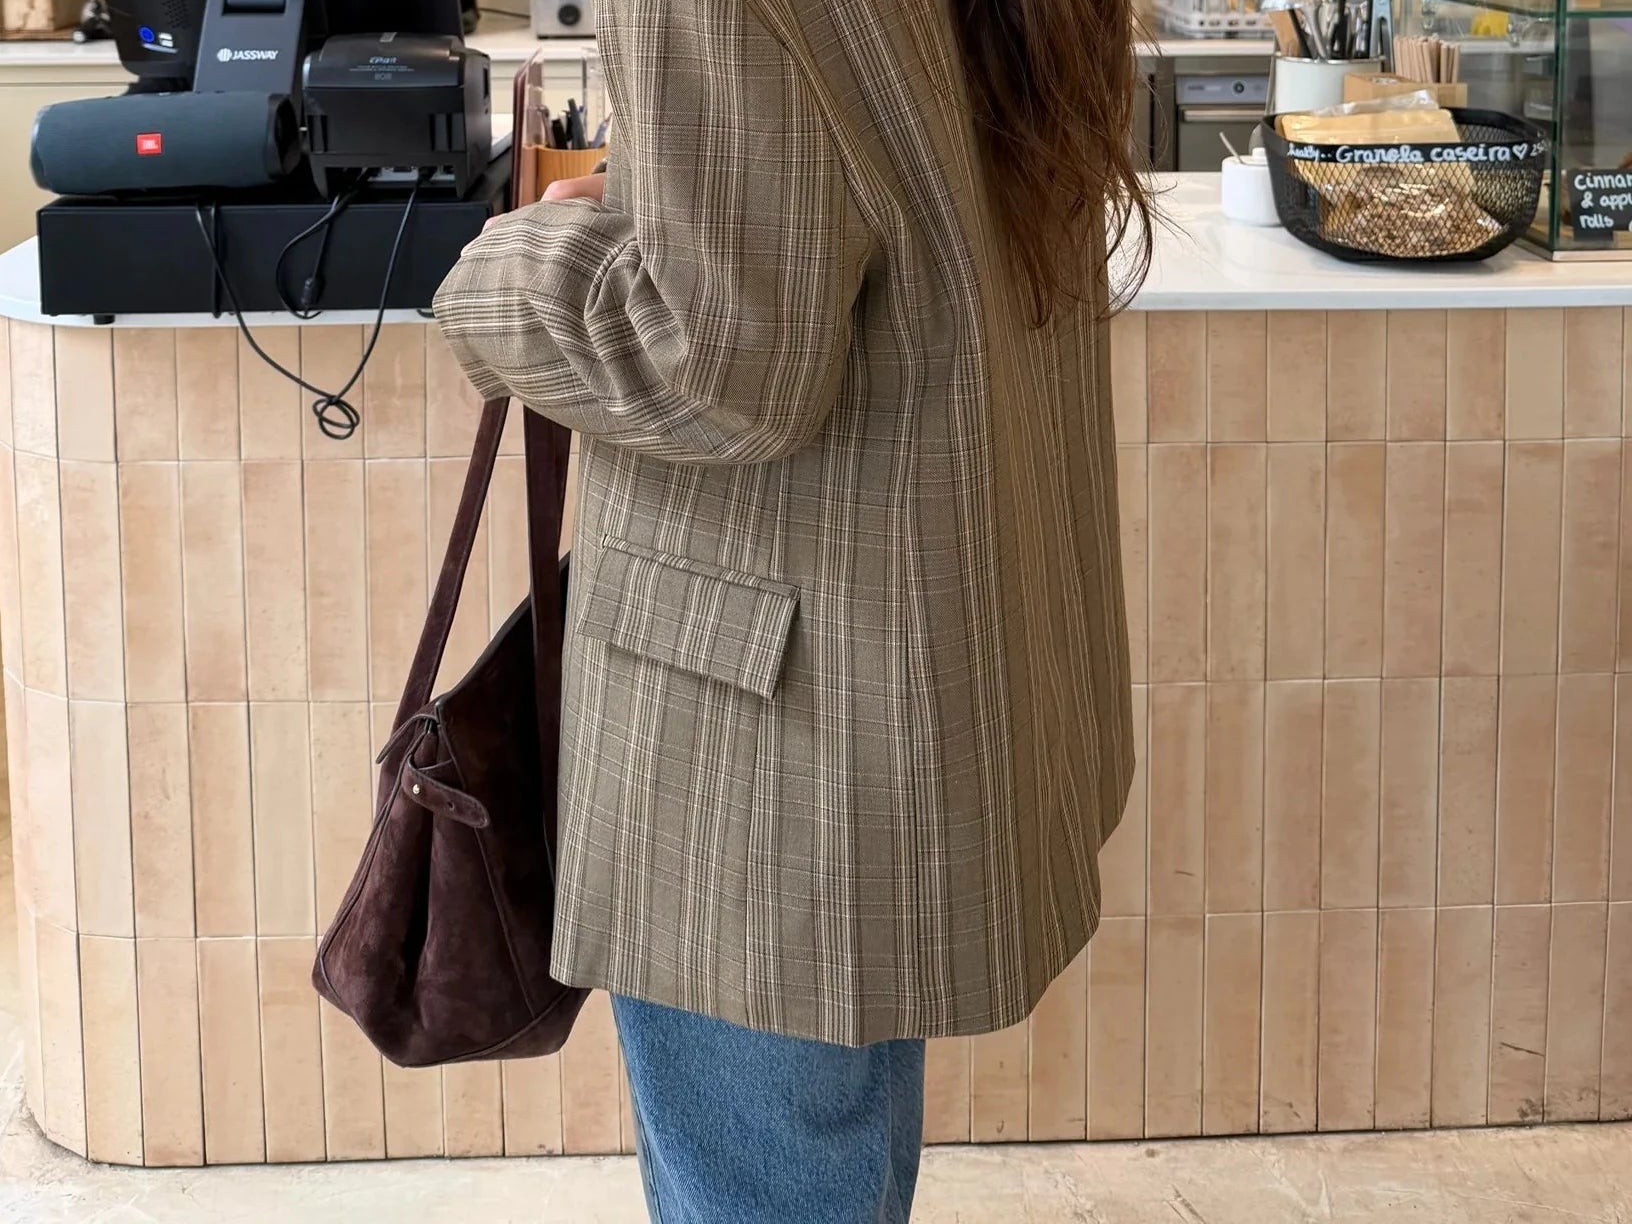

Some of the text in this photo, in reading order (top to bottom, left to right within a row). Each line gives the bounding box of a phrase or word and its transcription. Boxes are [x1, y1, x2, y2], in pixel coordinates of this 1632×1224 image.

[232, 50, 279, 61] JASSWAY
[1335, 145, 1425, 163] Granola
[1429, 143, 1511, 162] caseira
[1581, 191, 1595, 209] &
[1579, 213, 1615, 229] rolls
